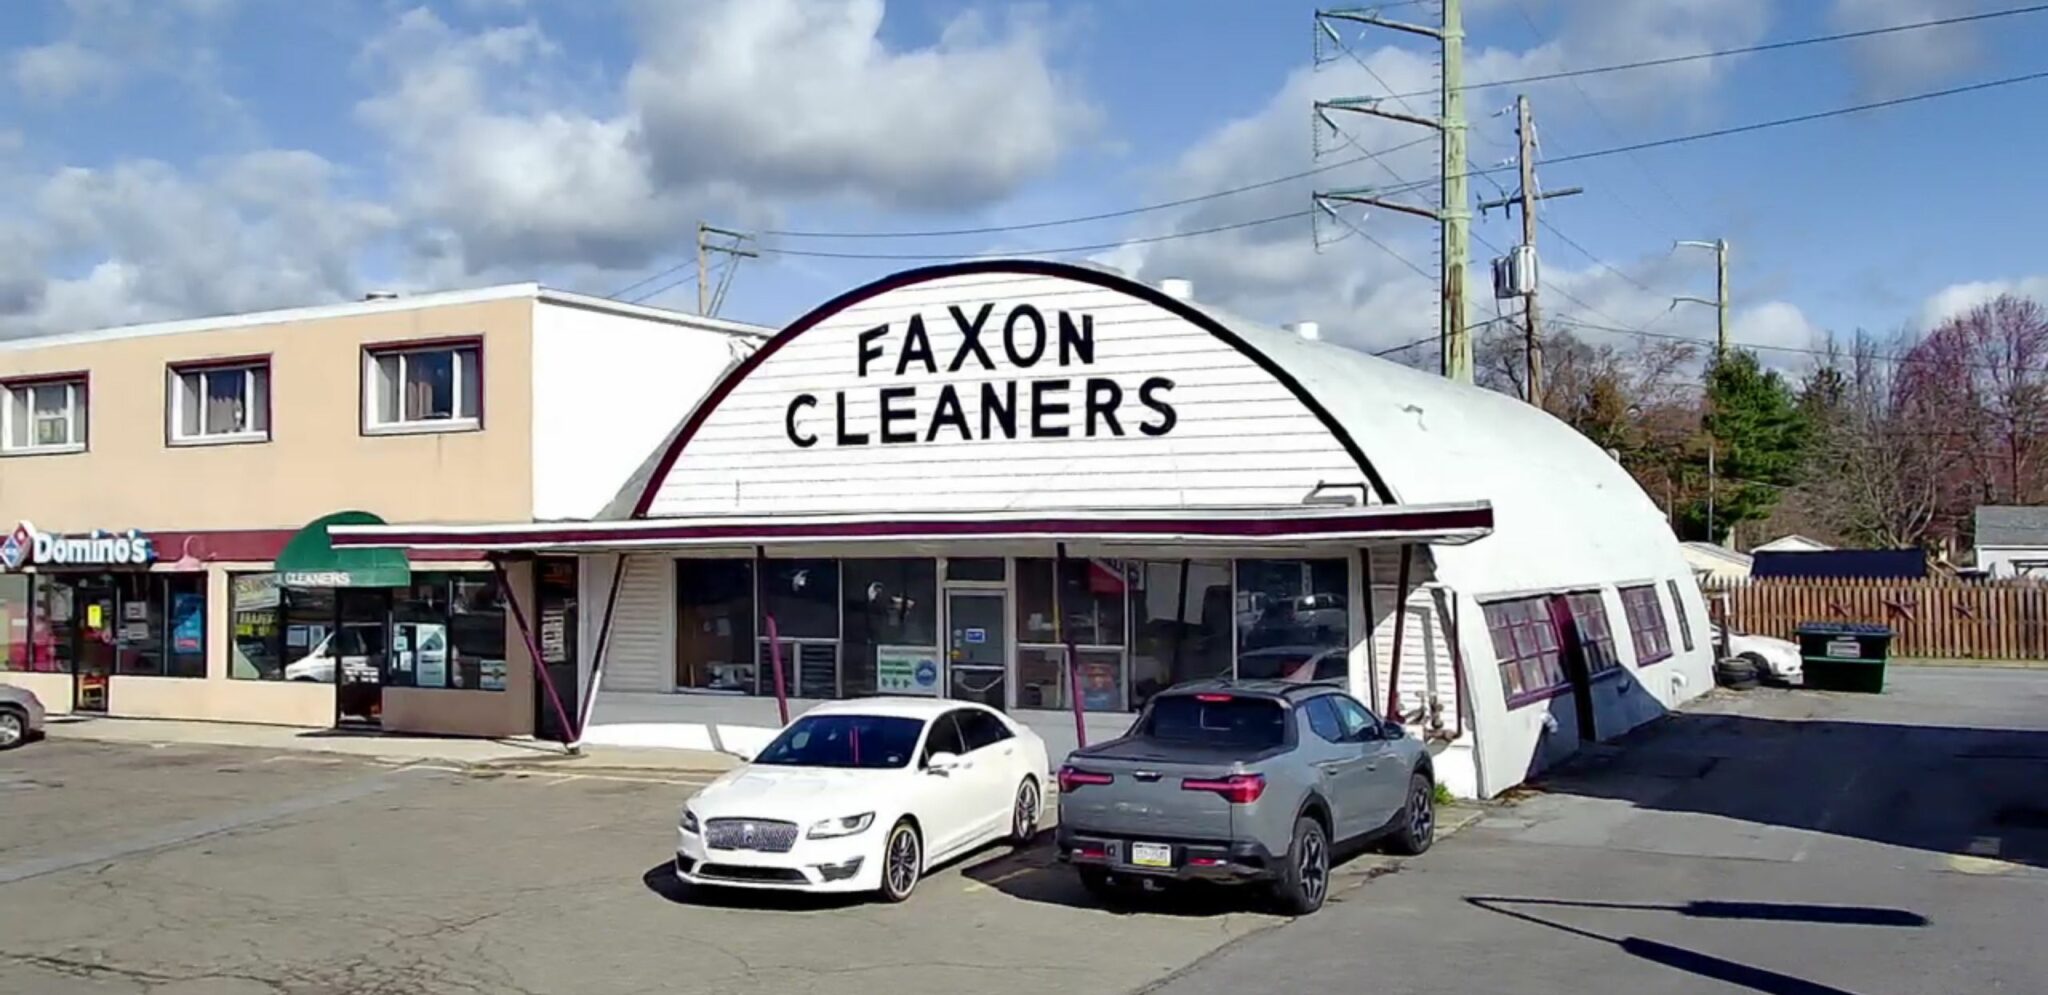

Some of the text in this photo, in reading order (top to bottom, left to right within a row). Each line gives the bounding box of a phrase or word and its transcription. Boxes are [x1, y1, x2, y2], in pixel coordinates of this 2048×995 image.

[858, 303, 1094, 377] FAXON
[786, 377, 1178, 447] CLEANERS
[33, 528, 148, 563] Domino's
[284, 572, 350, 586] CLEANERS
